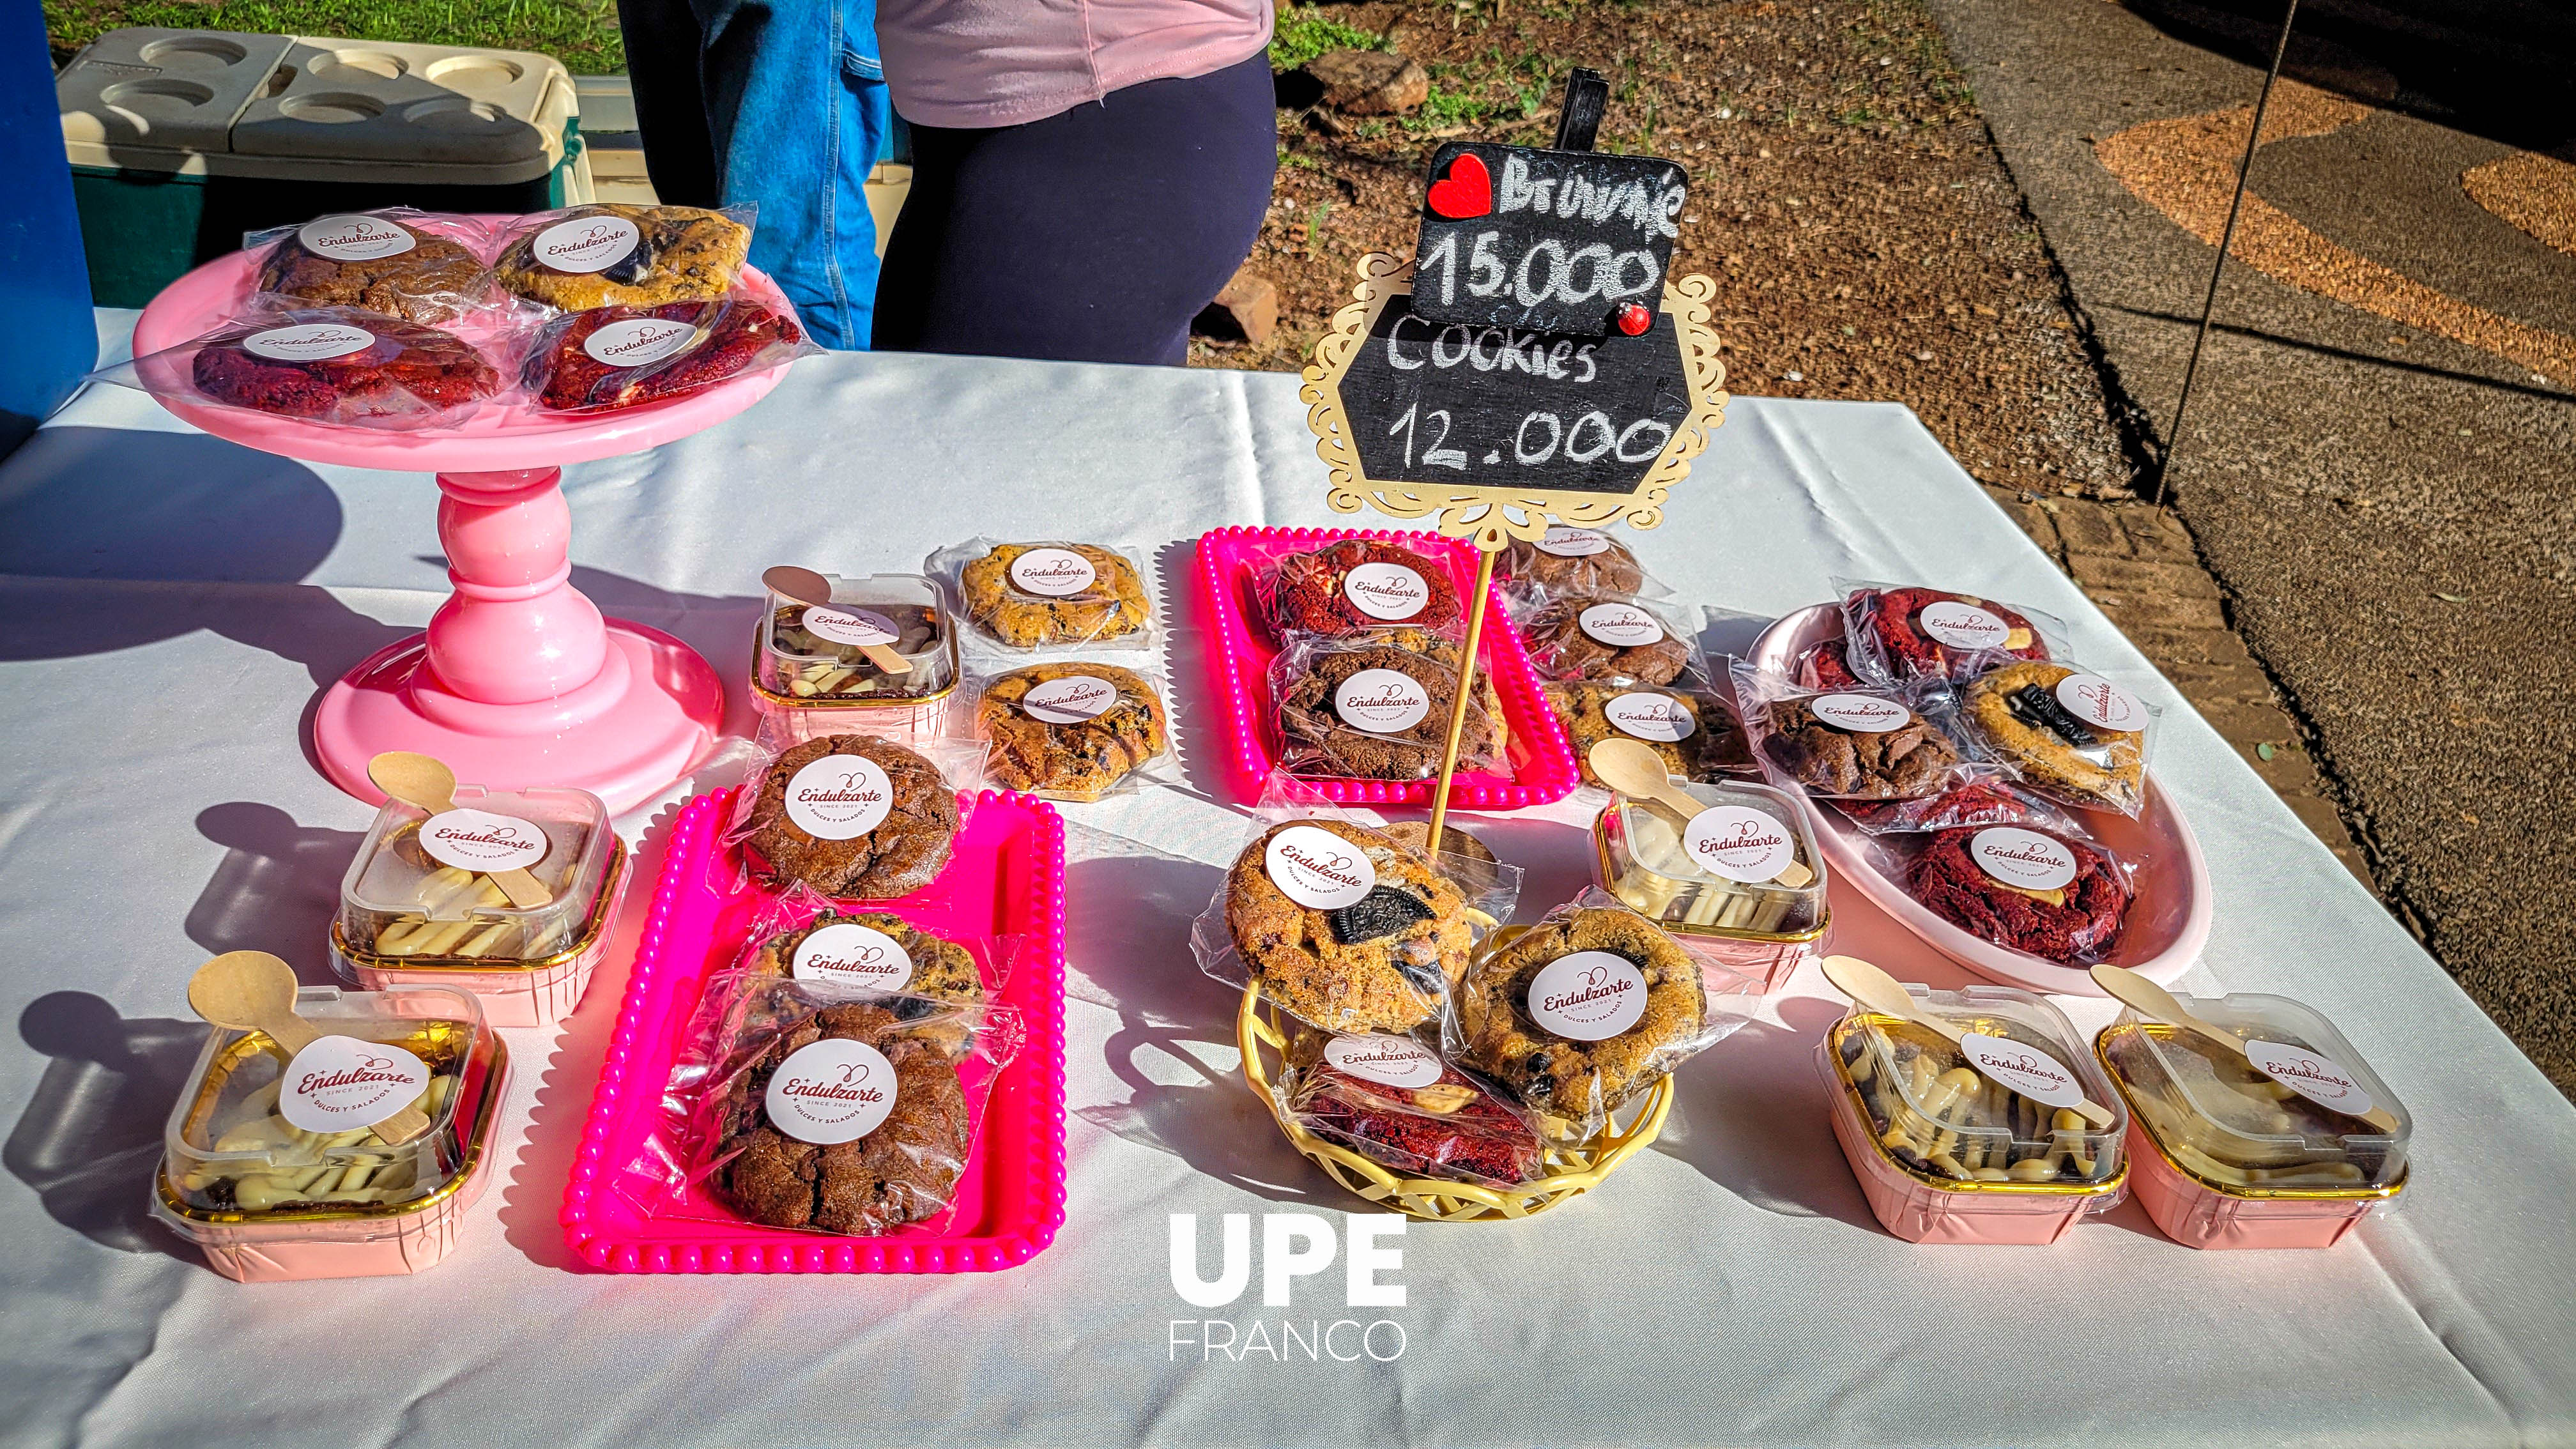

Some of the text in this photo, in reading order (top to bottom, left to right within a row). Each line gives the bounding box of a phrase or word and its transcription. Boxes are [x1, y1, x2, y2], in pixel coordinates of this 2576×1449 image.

[318, 232, 400, 247] Endulzarte
[548, 231, 627, 255] Endulzarte
[1420, 231, 1660, 307] 15.000
[259, 336, 362, 345] Endulzarte
[604, 328, 682, 356] Endulzarte
[1355, 582, 1420, 598] Endulzarte
[815, 616, 891, 633] Endulzarte
[1932, 618, 2000, 632] Endulzarte
[1035, 689, 1107, 707] Endulzarte
[1347, 696, 1420, 707] Endulzarte
[1824, 707, 1899, 716] Endulzarte
[798, 788, 882, 802] Endulzarte
[811, 808, 830, 822] DULCES
[435, 828, 535, 850] Endulzarte
[1699, 834, 1782, 854] Endulzarte
[1280, 845, 1361, 886] Endulzarte
[1717, 858, 1740, 868] DULCES
[1984, 845, 2066, 867] Endulzarte
[1288, 866, 1303, 885] DULCES
[808, 954, 900, 974] Endulzarte
[1544, 979, 1634, 1011] Endulzarte
[1563, 1014, 1589, 1023] DULCES
[1598, 1001, 1621, 1020] SALADOS
[1343, 1050, 1425, 1064] Endulzarte
[1980, 1054, 2067, 1082] Endulzarte
[2266, 1061, 2351, 1087] Endulzarte
[298, 1068, 415, 1094] Endulzarte
[783, 1078, 883, 1102] Endulzarte
[314, 1100, 339, 1112] DULCES
[351, 1089, 390, 1110] SALADOS
[794, 1105, 816, 1121] DULCES
[825, 1110, 859, 1124] SALADOS
